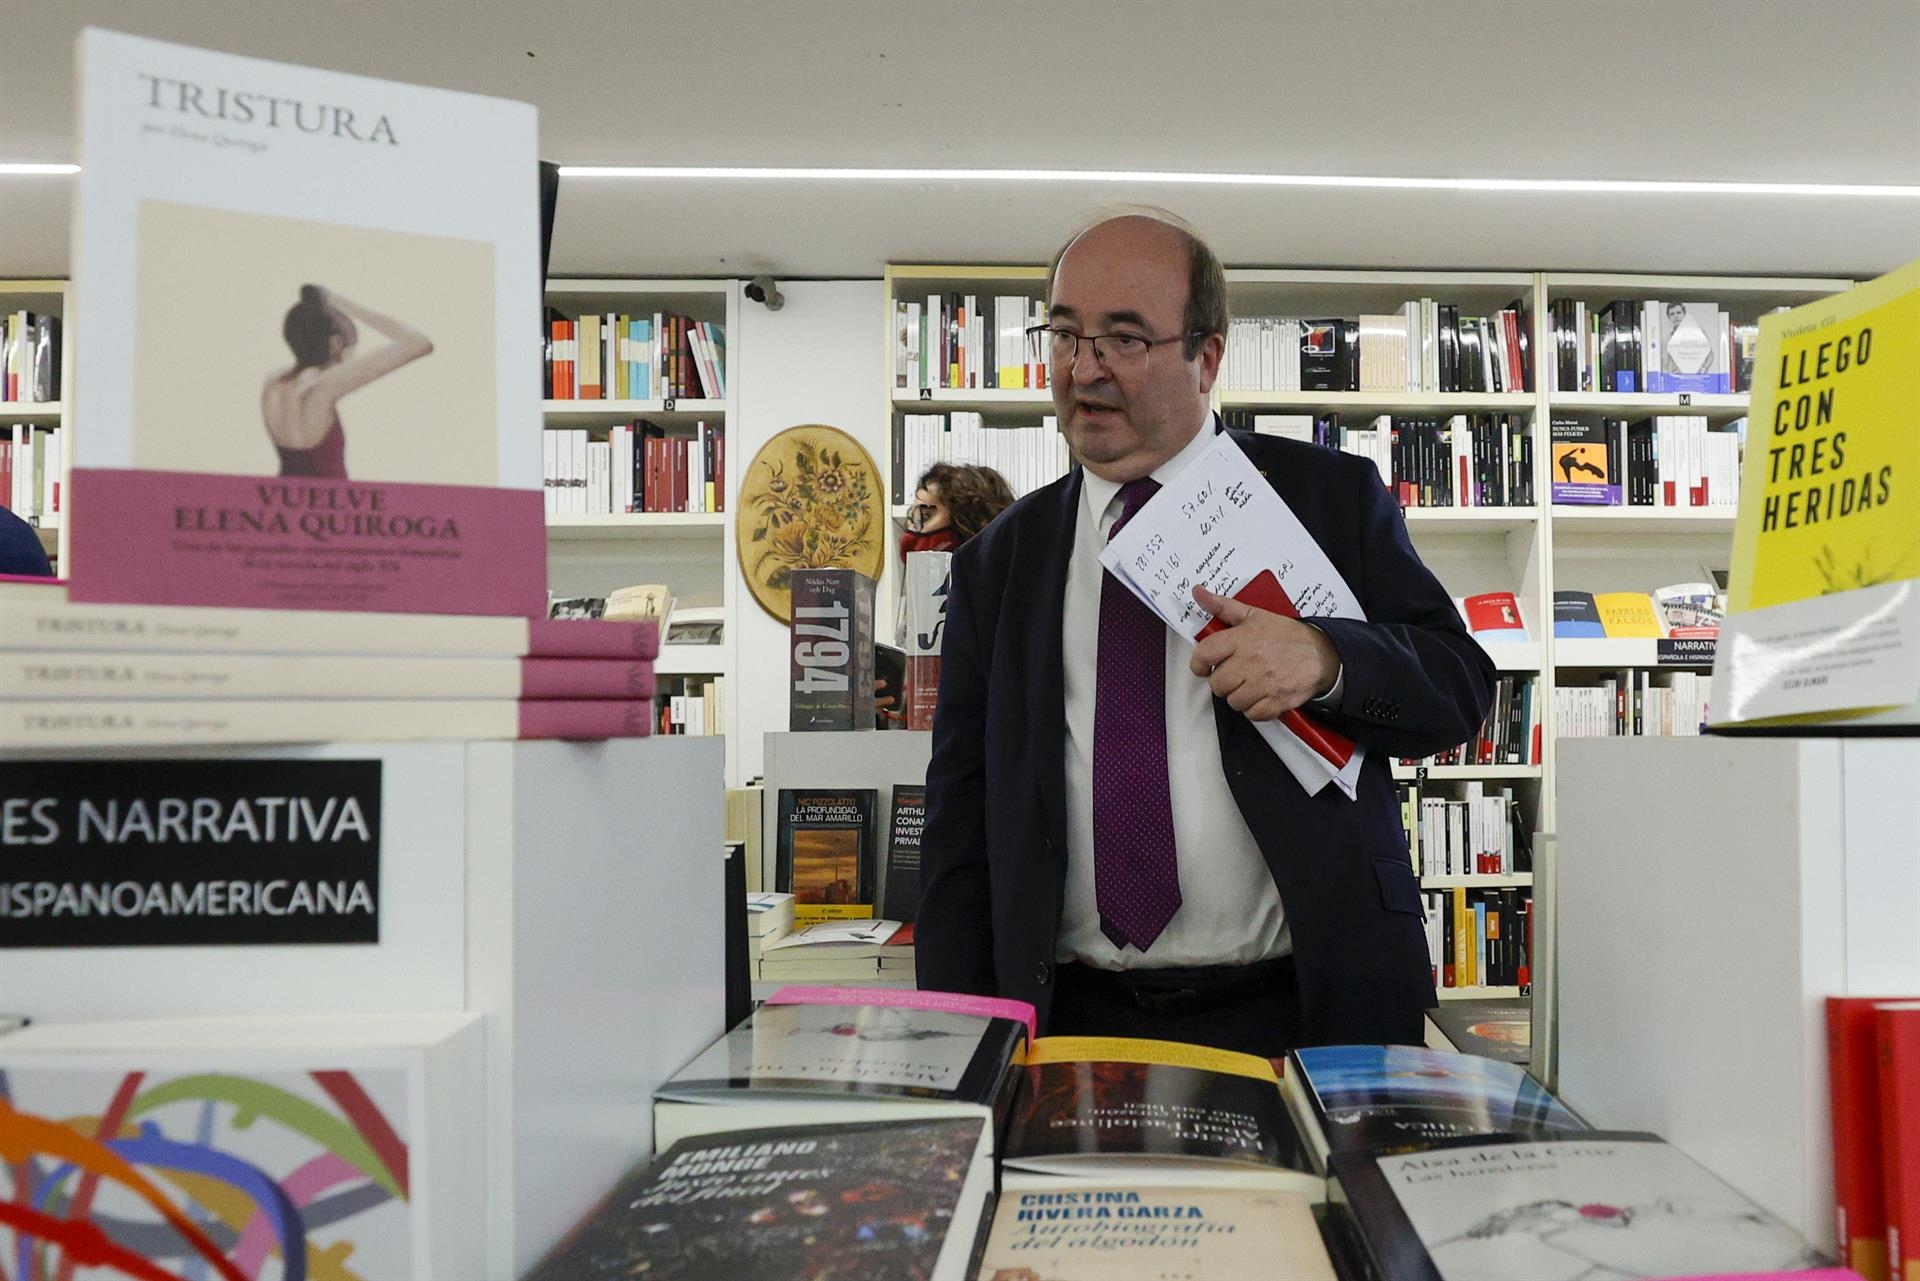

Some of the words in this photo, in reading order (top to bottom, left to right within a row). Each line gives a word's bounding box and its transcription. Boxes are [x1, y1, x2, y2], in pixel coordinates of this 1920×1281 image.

[138, 73, 399, 147] TRISTURA
[1779, 327, 1873, 390] LLEGO
[1680, 395, 1691, 405] M
[1774, 387, 1835, 436] CON
[1769, 431, 1847, 484] TRES
[256, 484, 383, 511] VUELVE
[1762, 464, 1892, 533] HERIDAS
[176, 507, 290, 534] ELENA
[299, 513, 460, 541] QUIROGA
[805, 578, 825, 586] Niklas
[822, 586, 836, 595] Dag
[794, 600, 850, 695] 1794
[77, 796, 372, 843] NARRATIVA
[790, 814, 803, 822] DEL
[806, 814, 823, 822] MAR
[825, 814, 863, 822] AMARILLO
[796, 806, 805, 814] LA
[807, 806, 858, 814] PROFUNDIDAD
[674, 1140, 818, 1166] EMILIANO
[1471, 1152, 1504, 1162] de
[1512, 1149, 1536, 1159] la
[657, 1156, 773, 1181] MONGE
[1020, 1191, 1140, 1207] CRISTINA
[1016, 1206, 1112, 1222] RIVERA
[1117, 1206, 1204, 1219] GARZA
[1010, 1236, 1062, 1250] del
